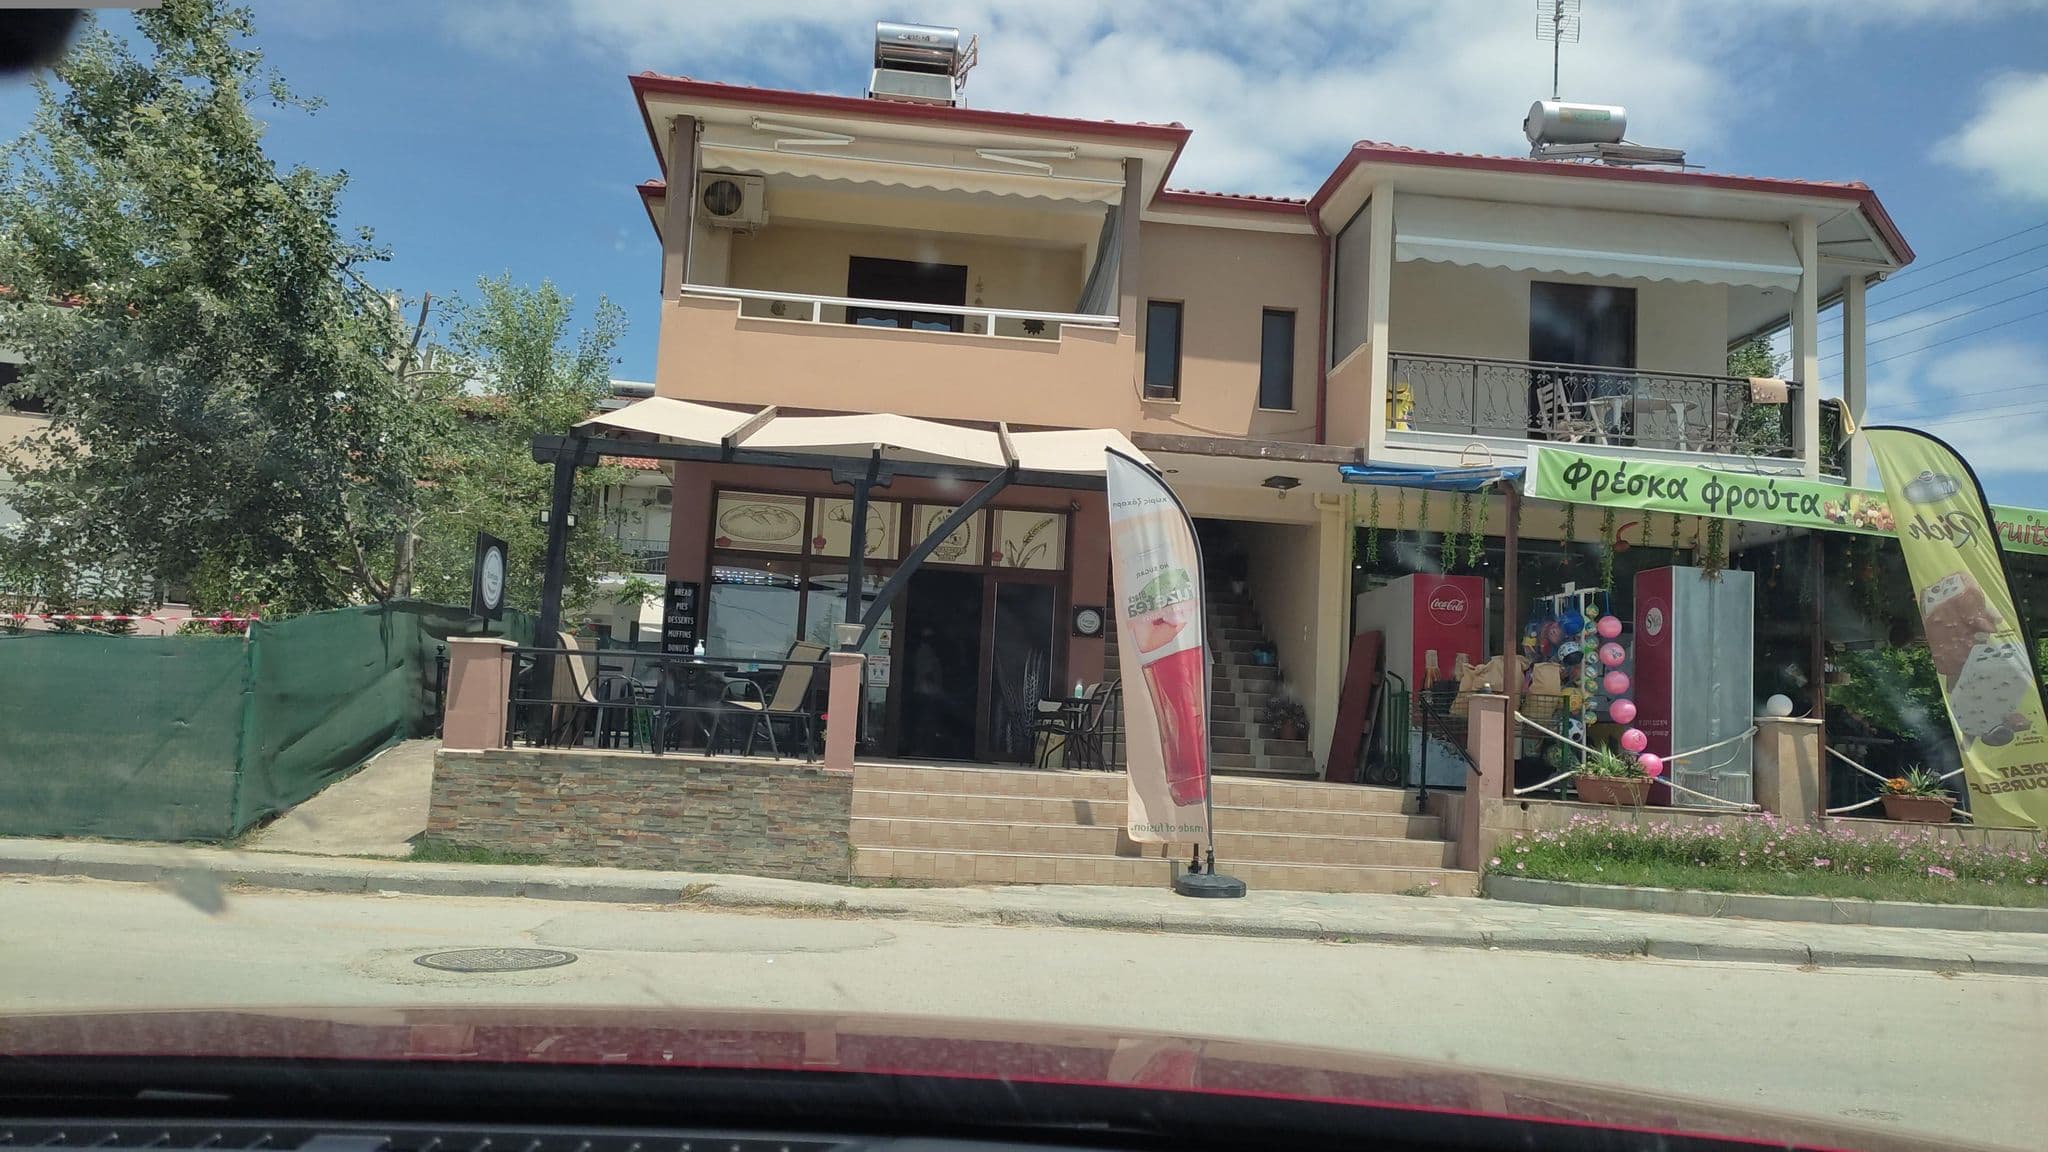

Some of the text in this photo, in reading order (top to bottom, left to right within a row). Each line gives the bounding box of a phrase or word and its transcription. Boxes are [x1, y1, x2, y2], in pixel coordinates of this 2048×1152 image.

[1563, 458, 1821, 517] Φρέσκα φρούτα
[1989, 508, 2048, 547] ruit
[674, 588, 693, 597] BREAD
[676, 602, 688, 611] PIES
[1431, 598, 1465, 612] Coca-Cola
[668, 615, 694, 625] DESSERTS
[668, 630, 692, 639] MUFFINS
[668, 643, 690, 653] DONUTS
